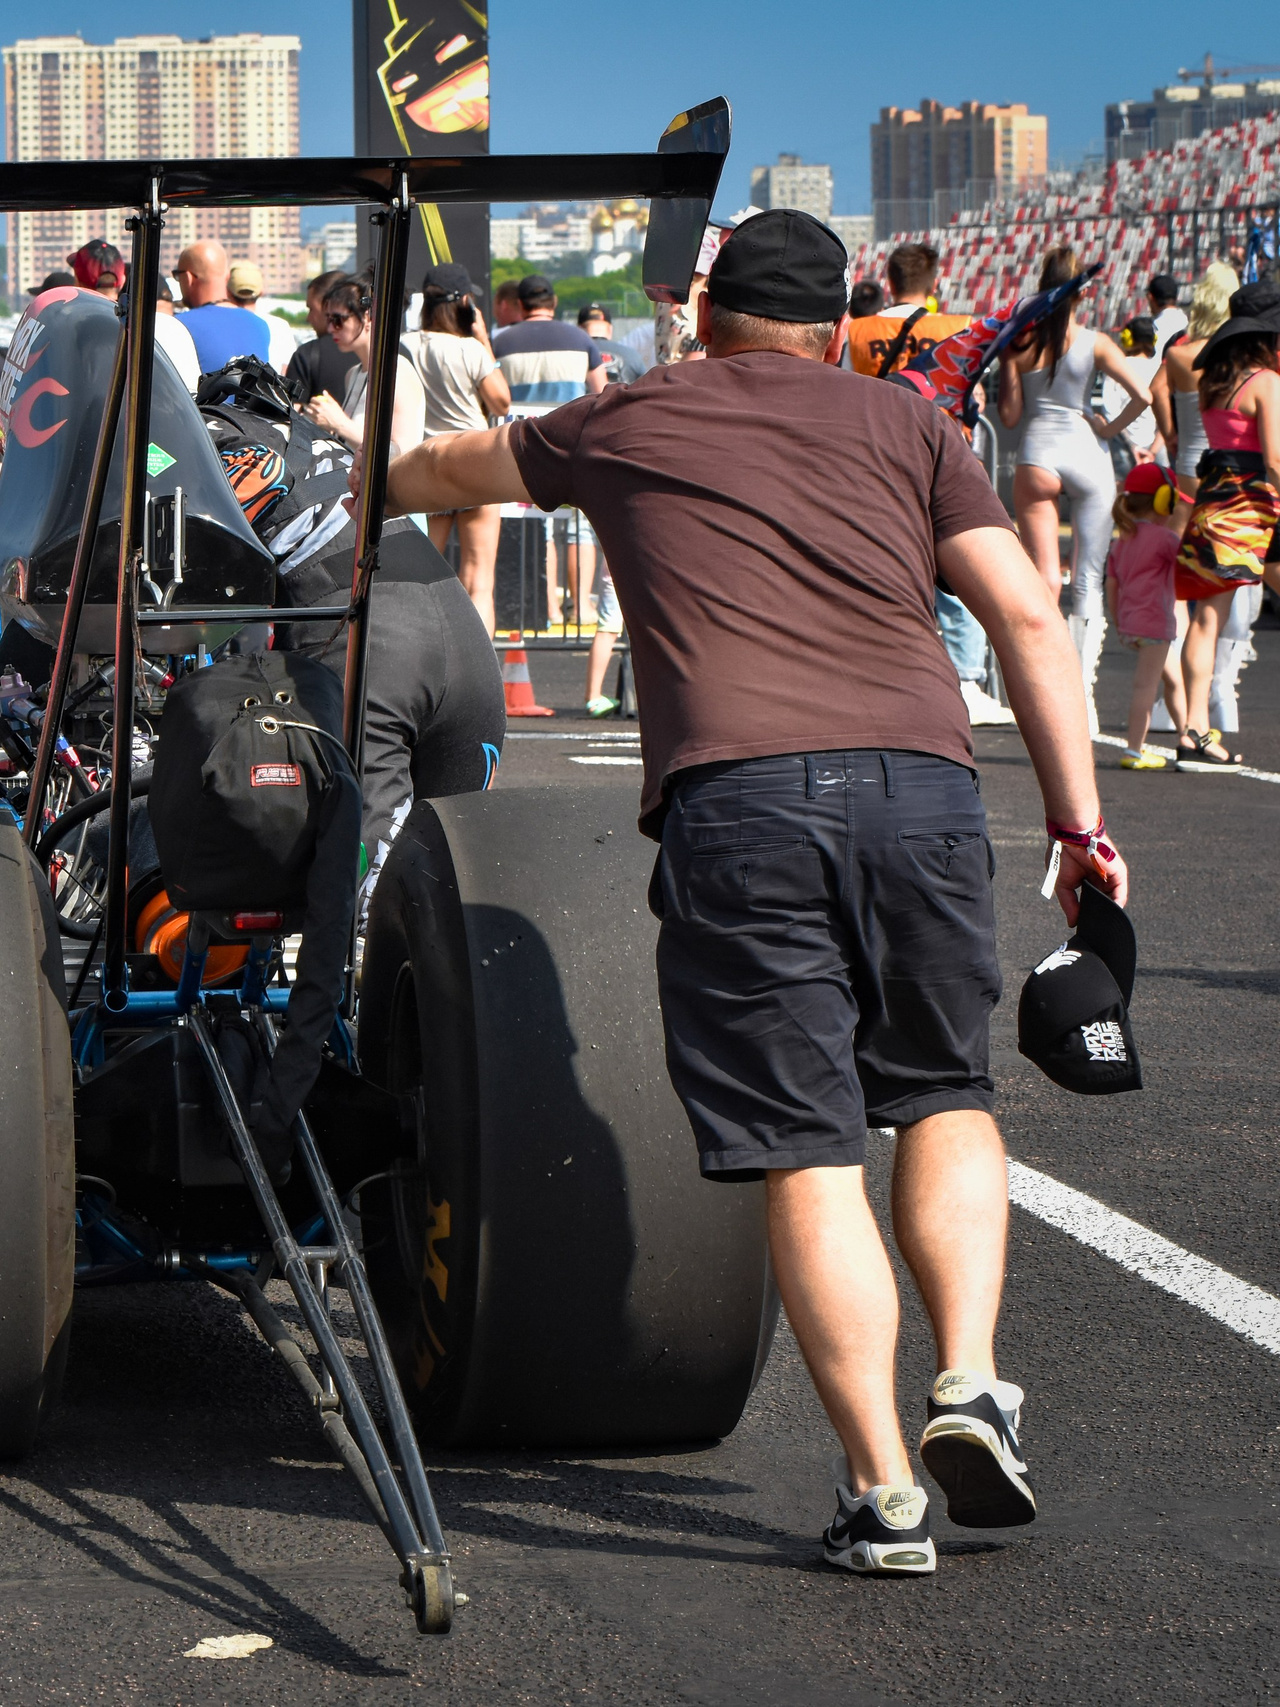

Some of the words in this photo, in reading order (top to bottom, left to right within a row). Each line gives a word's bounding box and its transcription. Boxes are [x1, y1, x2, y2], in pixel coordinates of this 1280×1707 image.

[1080, 1021, 1103, 1061] MAX
[1099, 1021, 1120, 1062] RIDE
[1111, 1022, 1127, 1062] MOTORSPORT
